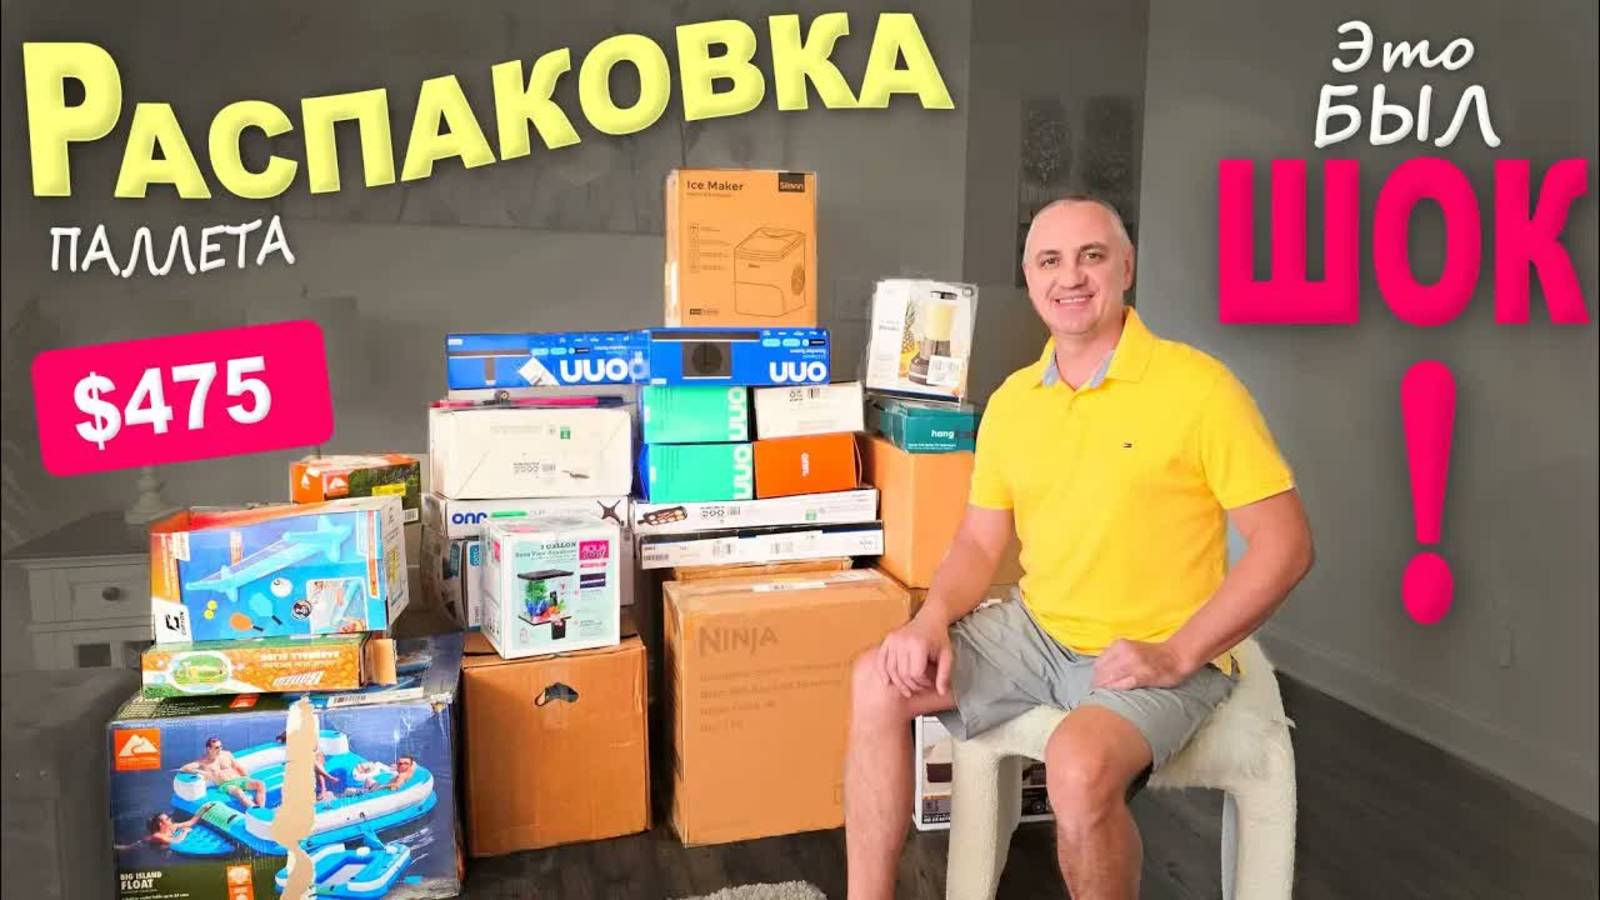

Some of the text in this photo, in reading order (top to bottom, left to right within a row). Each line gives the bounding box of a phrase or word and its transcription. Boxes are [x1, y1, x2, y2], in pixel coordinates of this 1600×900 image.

[687, 181, 744, 191] Ice Maker
[560, 358, 629, 383] onn
[769, 361, 827, 383] onn
[728, 386, 747, 441] onn
[733, 444, 753, 500] onn
[699, 626, 779, 655] NINJA
[120, 871, 162, 881] BIG ISLAND
[121, 879, 155, 890] FLOAT
